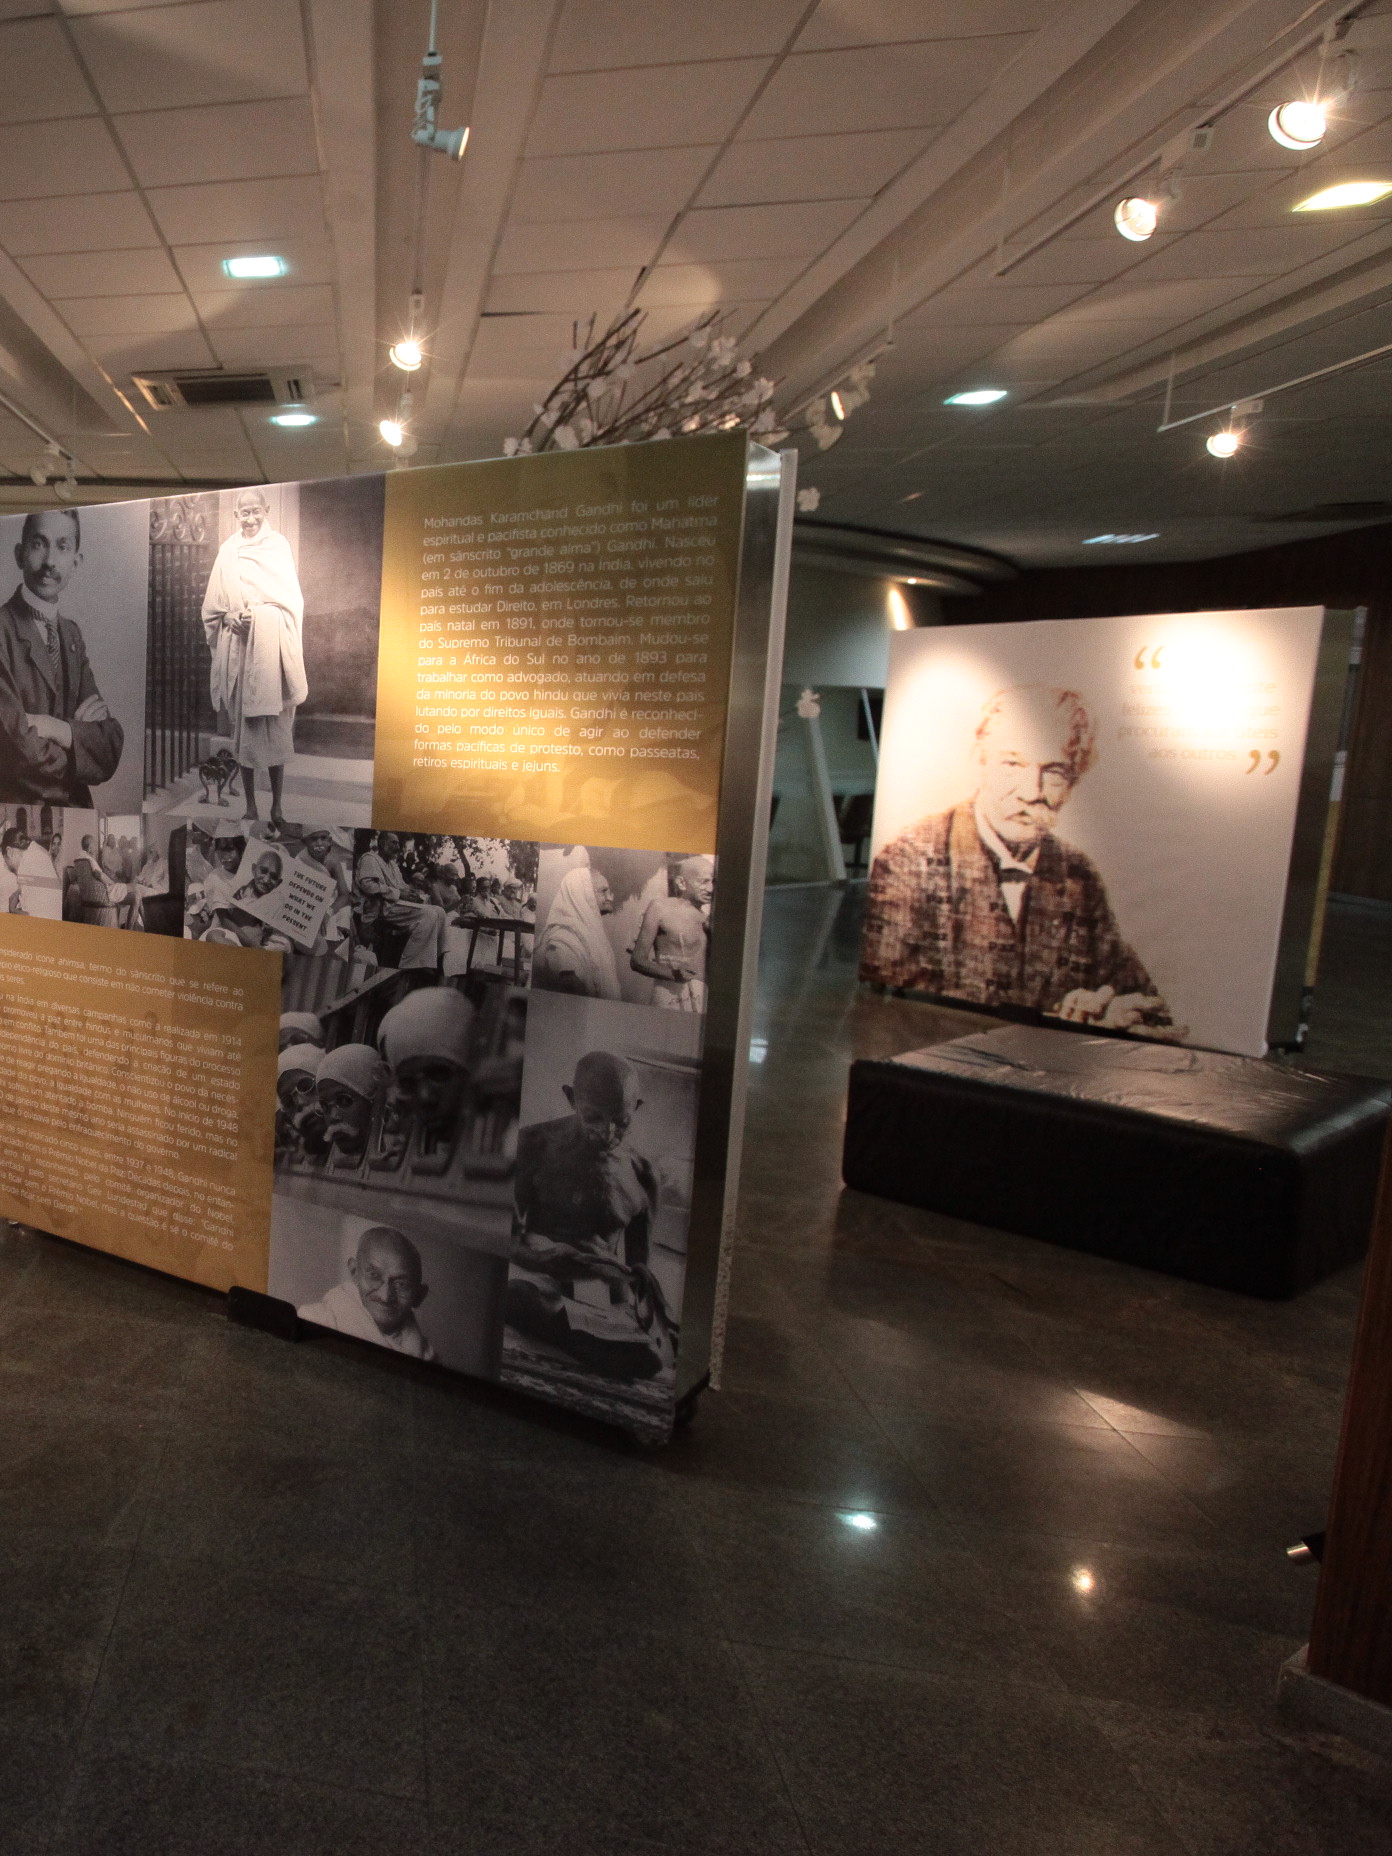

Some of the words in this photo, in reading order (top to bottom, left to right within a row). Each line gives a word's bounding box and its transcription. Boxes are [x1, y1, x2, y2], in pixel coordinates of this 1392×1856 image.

[423, 531, 474, 547] espiritual
[477, 533, 484, 542] e
[488, 528, 537, 544] pacifista
[540, 522, 606, 537] conhecido
[610, 522, 648, 532] como
[423, 552, 445, 566] (em
[422, 571, 440, 579] em
[444, 568, 451, 578] 2
[455, 567, 469, 578] de
[473, 565, 520, 577] outubro
[523, 563, 540, 575] de
[544, 561, 575, 574] 1869
[578, 563, 594, 572] na
[472, 587, 480, 595] o
[485, 583, 503, 594] fim
[509, 582, 525, 593] da
[620, 577, 636, 588] de
[643, 575, 679, 587] onde
[420, 605, 445, 616] para
[449, 601, 493, 613] estudar
[542, 601, 561, 610] em
[626, 596, 689, 607] Retornou
[694, 595, 712, 604] ao
[448, 618, 475, 630] natal
[481, 621, 500, 629] em
[541, 616, 575, 628] onde
[580, 617, 643, 627] tornou-se
[650, 612, 710, 625] membro
[418, 637, 434, 648] do
[438, 637, 490, 650] Supremo
[495, 635, 542, 647] Tribunal
[547, 635, 563, 646] de
[640, 633, 709, 644] Mudou-se
[418, 657, 443, 668] para
[450, 657, 457, 665] a
[504, 654, 520, 664] do
[527, 653, 545, 664] Sul
[553, 656, 569, 664] no
[576, 656, 601, 664] ano
[608, 653, 626, 664] de
[636, 653, 667, 663] 1893
[676, 655, 708, 666] para
[417, 671, 468, 682] trabalhar
[471, 674, 504, 682] como
[575, 671, 629, 682] atuando
[633, 674, 655, 682] em
[660, 671, 706, 682] defesa
[416, 688, 431, 699] da
[435, 688, 477, 699] minoria
[480, 688, 496, 699] do
[500, 692, 529, 702] povo
[534, 689, 568, 700] hindu
[573, 692, 598, 703] que
[602, 689, 630, 700] vivia
[635, 691, 671, 700] neste
[416, 705, 458, 717] lutando
[461, 709, 480, 719] por
[483, 706, 527, 718] direitos
[571, 708, 616, 719] Gandhi
[415, 722, 430, 733] do
[438, 723, 462, 736] pelo
[470, 724, 505, 735] modo
[554, 725, 571, 736] de
[579, 726, 604, 739] agir
[613, 729, 630, 737] ao
[639, 726, 700, 738] defender
[414, 738, 452, 750] formas
[510, 741, 526, 753] de
[588, 747, 625, 756] como
[413, 755, 447, 767] retiros
[451, 757, 508, 771] espirituais
[512, 762, 519, 770] e
[294, 871, 304, 879] THE
[305, 877, 327, 892] FUTURE
[289, 881, 314, 897] DEPENDS
[315, 894, 324, 902] ON
[289, 893, 306, 906] WHAT
[307, 902, 316, 911] WE
[282, 914, 307, 931] PRESENT
[302, 911, 312, 921] THE
